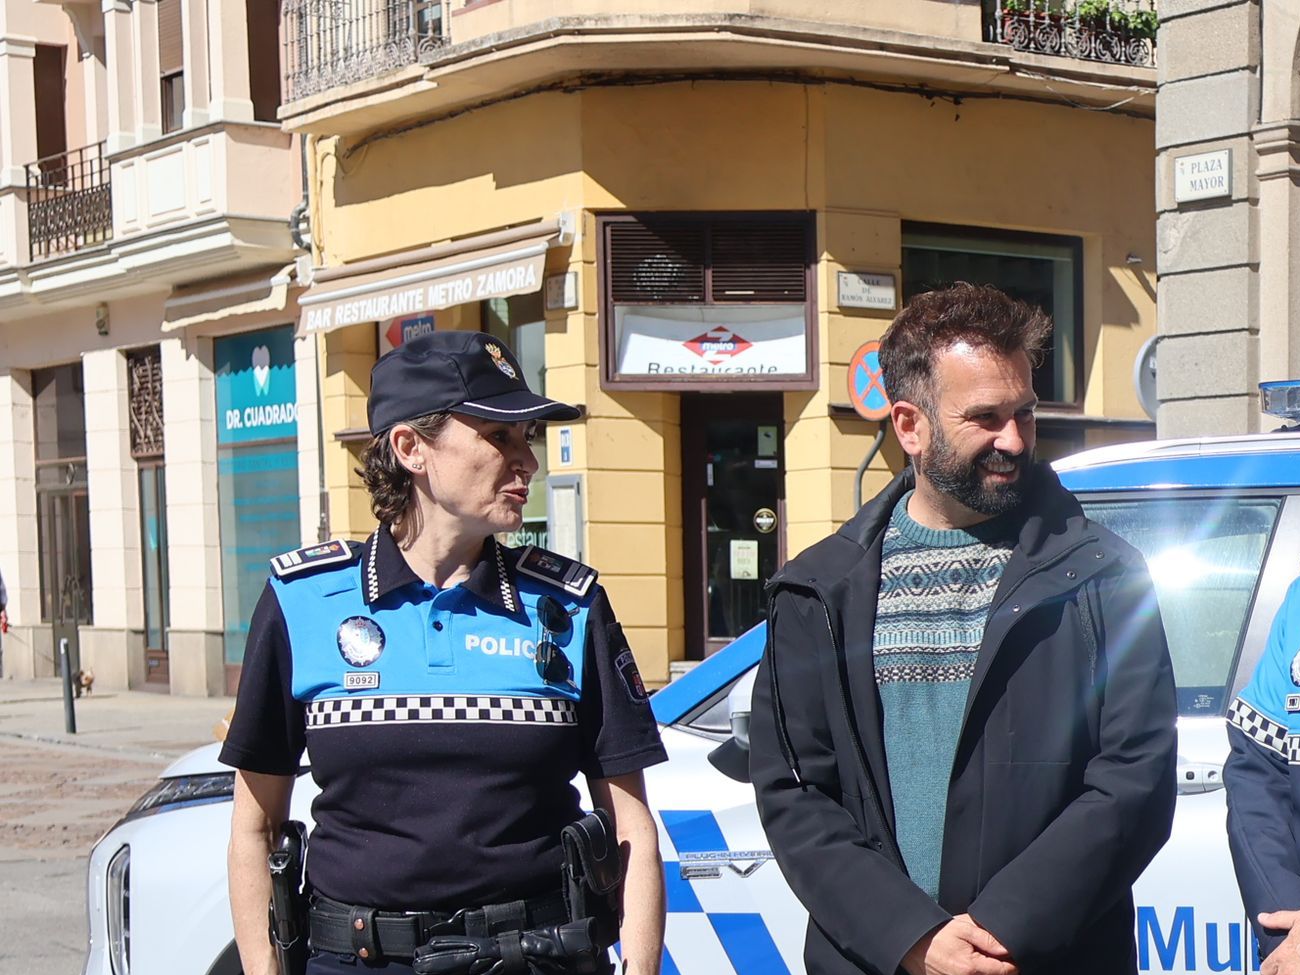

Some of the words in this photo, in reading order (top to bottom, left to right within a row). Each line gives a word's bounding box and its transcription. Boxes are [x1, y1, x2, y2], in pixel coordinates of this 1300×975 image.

[1191, 159, 1223, 174] PLAZA
[1190, 175, 1225, 192] MAYOR
[306, 308, 332, 331] BAR
[335, 289, 424, 327] RESTAURANTE
[428, 280, 473, 307] METRO
[476, 264, 536, 296] ZAMORA
[702, 341, 734, 352] metro
[226, 408, 244, 430] DR.
[349, 676, 373, 685] 9092
